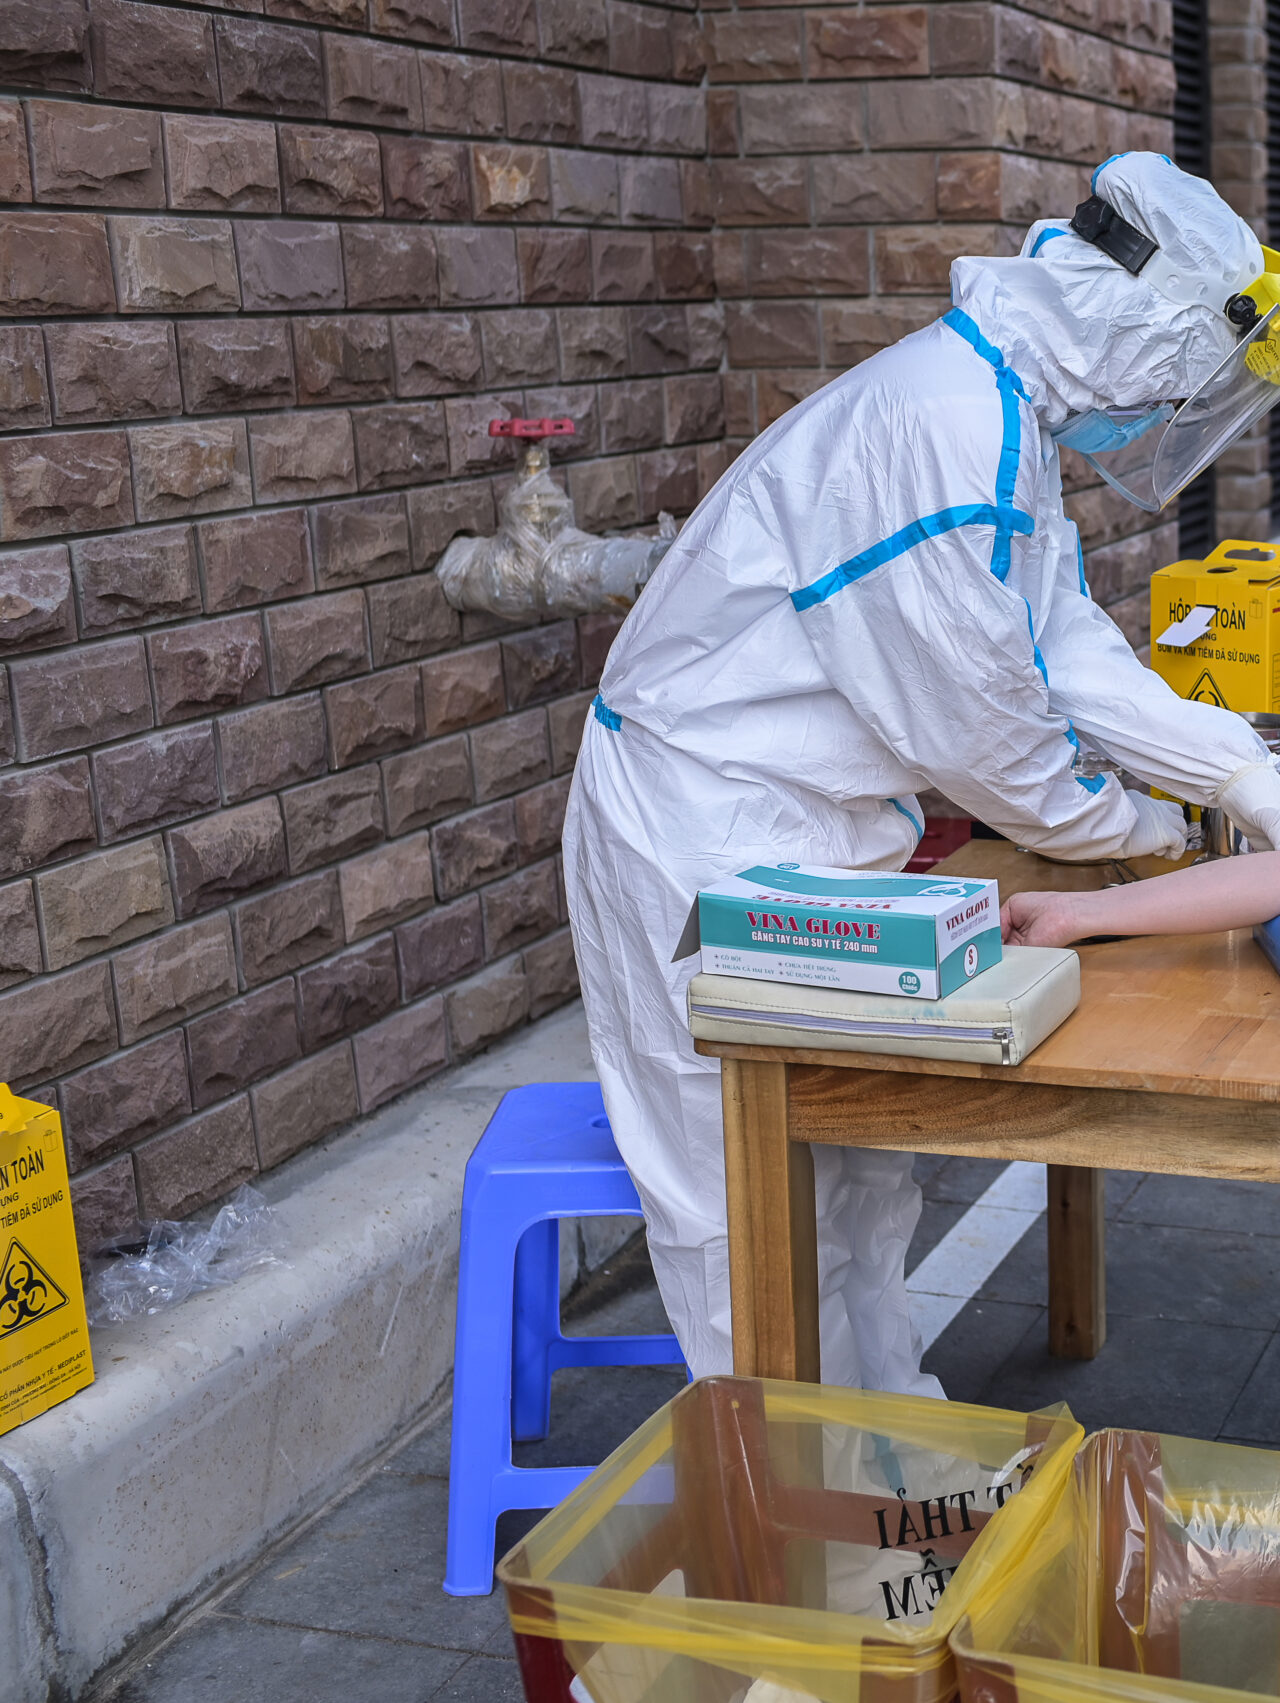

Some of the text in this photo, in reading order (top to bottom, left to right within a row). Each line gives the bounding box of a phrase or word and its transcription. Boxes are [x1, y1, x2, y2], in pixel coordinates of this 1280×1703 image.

[1214, 602, 1245, 630] TOÀN
[1200, 632, 1217, 642] ỰNG
[1239, 652, 1260, 665] DỤNG
[945, 912, 964, 931] VINA
[966, 896, 990, 920] GLOVE
[745, 911, 881, 940] VINA GLOVE
[751, 931, 878, 953] GĂNG TAY CAO SU Y TẾ 240 mm
[968, 948, 974, 965] S
[901, 975, 917, 985] 100
[11, 1145, 45, 1184] TOÀN
[20, 1202, 31, 1220] ĐÃ
[43, 1189, 63, 1209] DỤNG
[57, 1350, 86, 1370] MEDIPLAST
